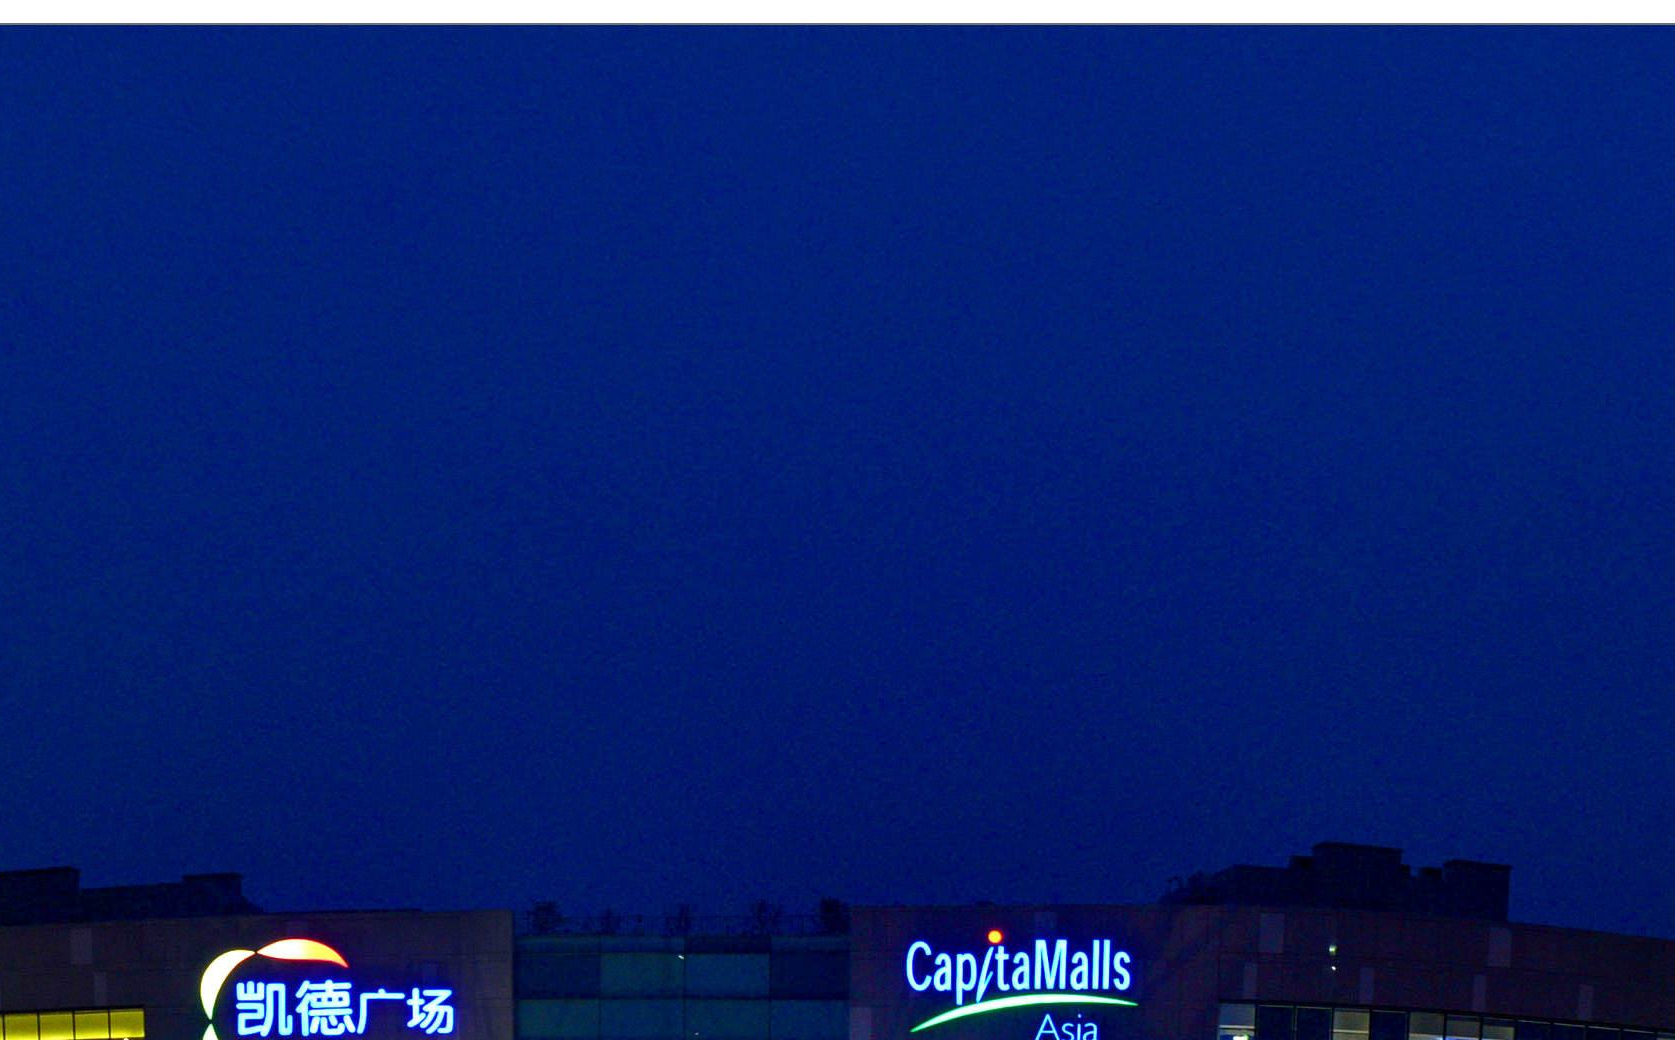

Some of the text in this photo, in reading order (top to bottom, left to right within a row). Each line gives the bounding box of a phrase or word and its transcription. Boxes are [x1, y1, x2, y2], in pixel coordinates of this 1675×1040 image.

[906, 930, 1133, 1006] CapitaMalls
[235, 979, 456, 1037] 凯德广场
